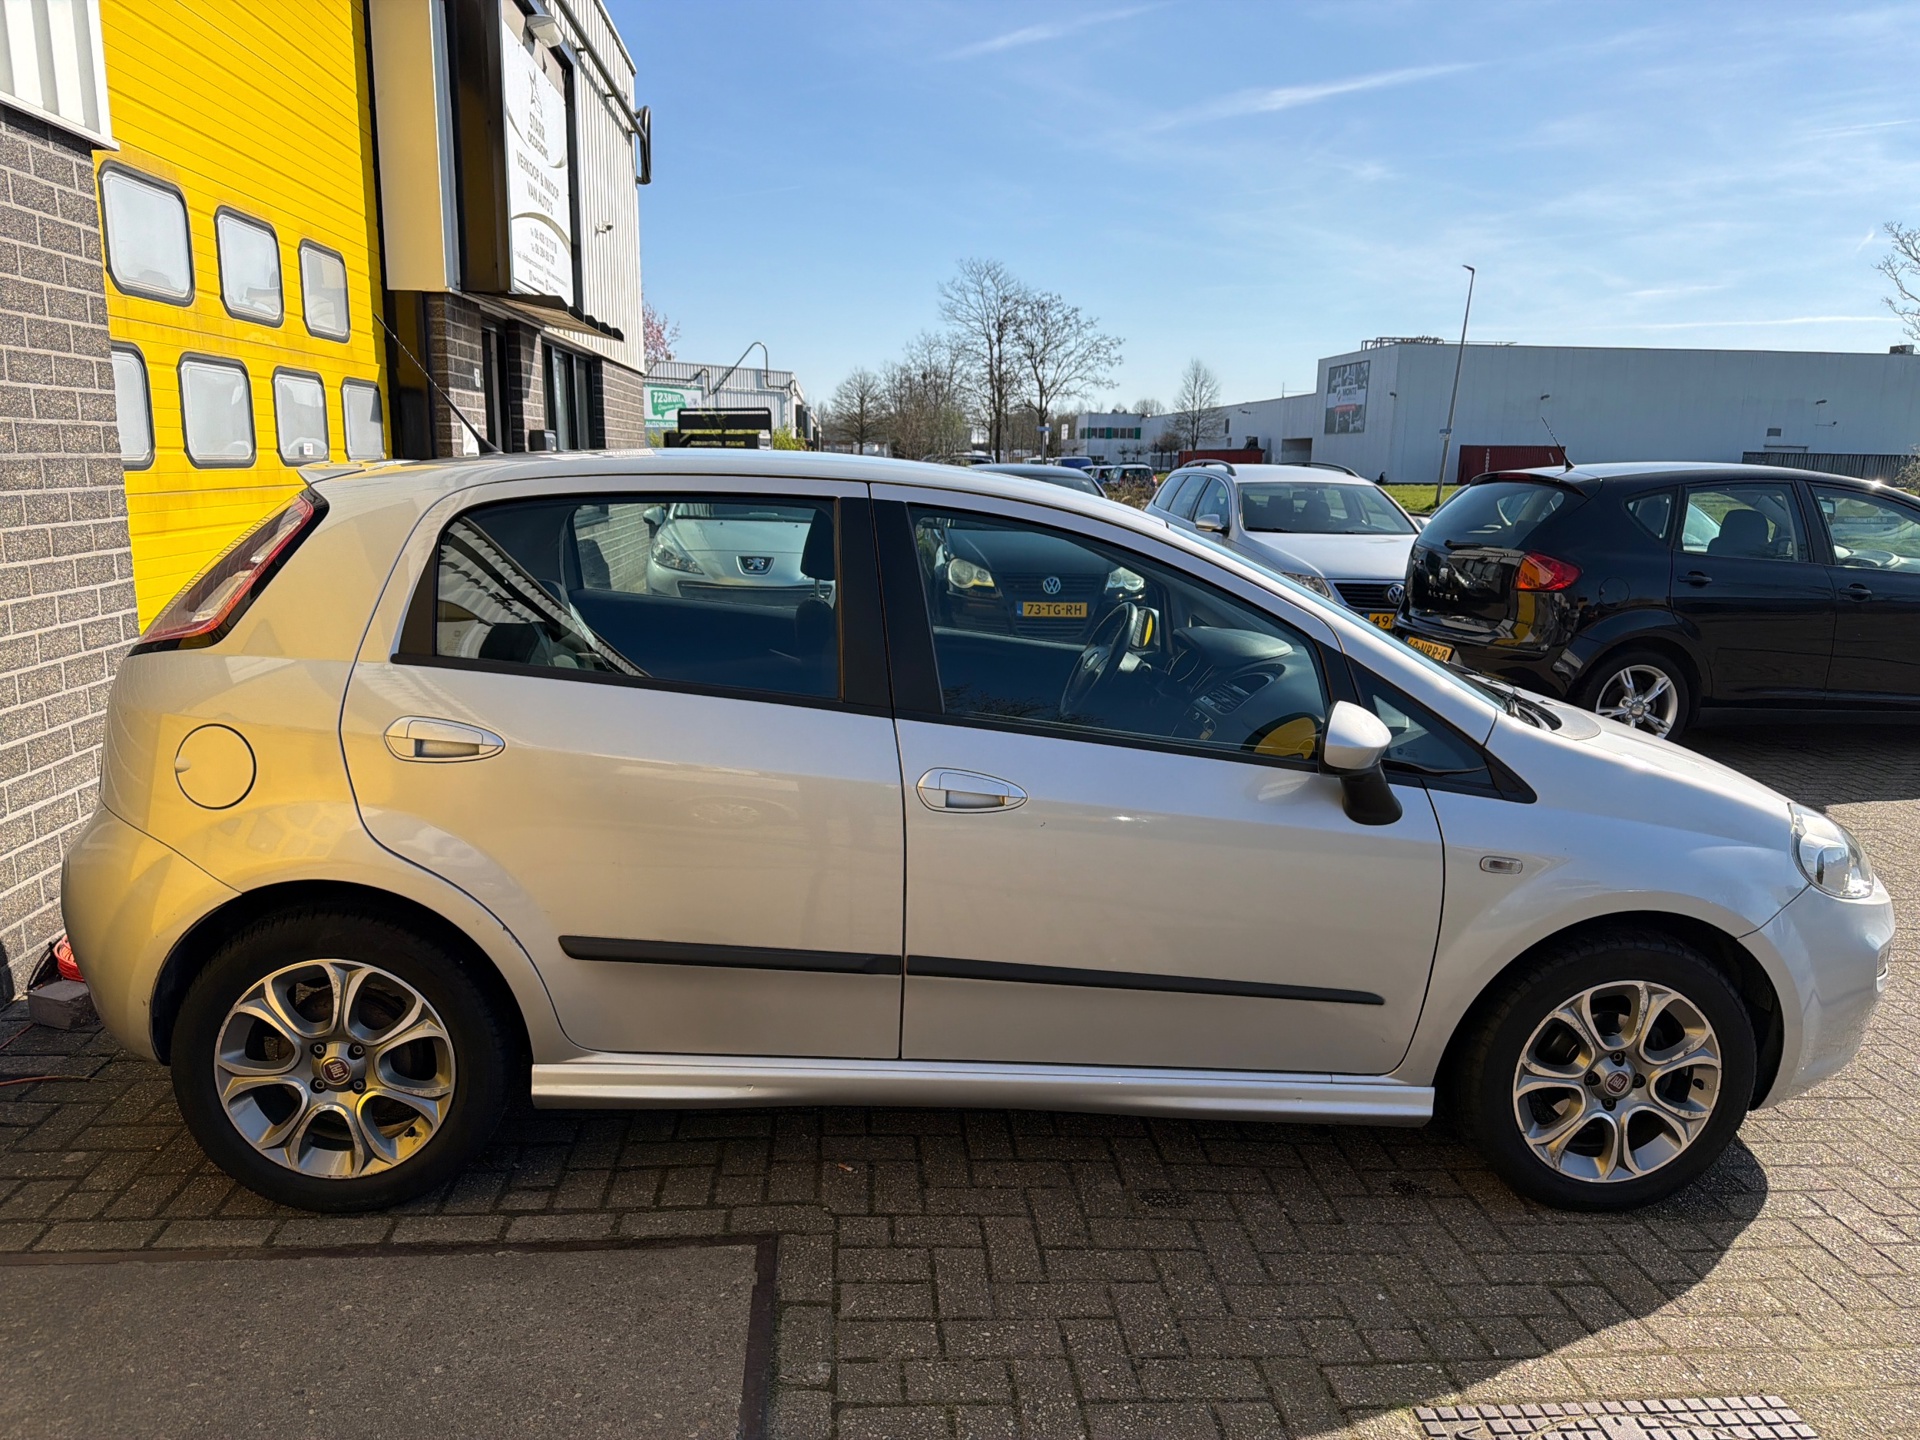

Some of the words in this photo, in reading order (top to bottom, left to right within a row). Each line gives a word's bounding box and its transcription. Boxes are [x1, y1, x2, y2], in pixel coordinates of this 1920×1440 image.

[516, 149, 539, 182] VERKOOP
[544, 175, 559, 201] INKOOP
[527, 180, 537, 202] VAN
[1027, 604, 1082, 616] 73-TG-RH
[329, 1063, 345, 1078] FIAT
[1610, 1075, 1626, 1090] FIAT
